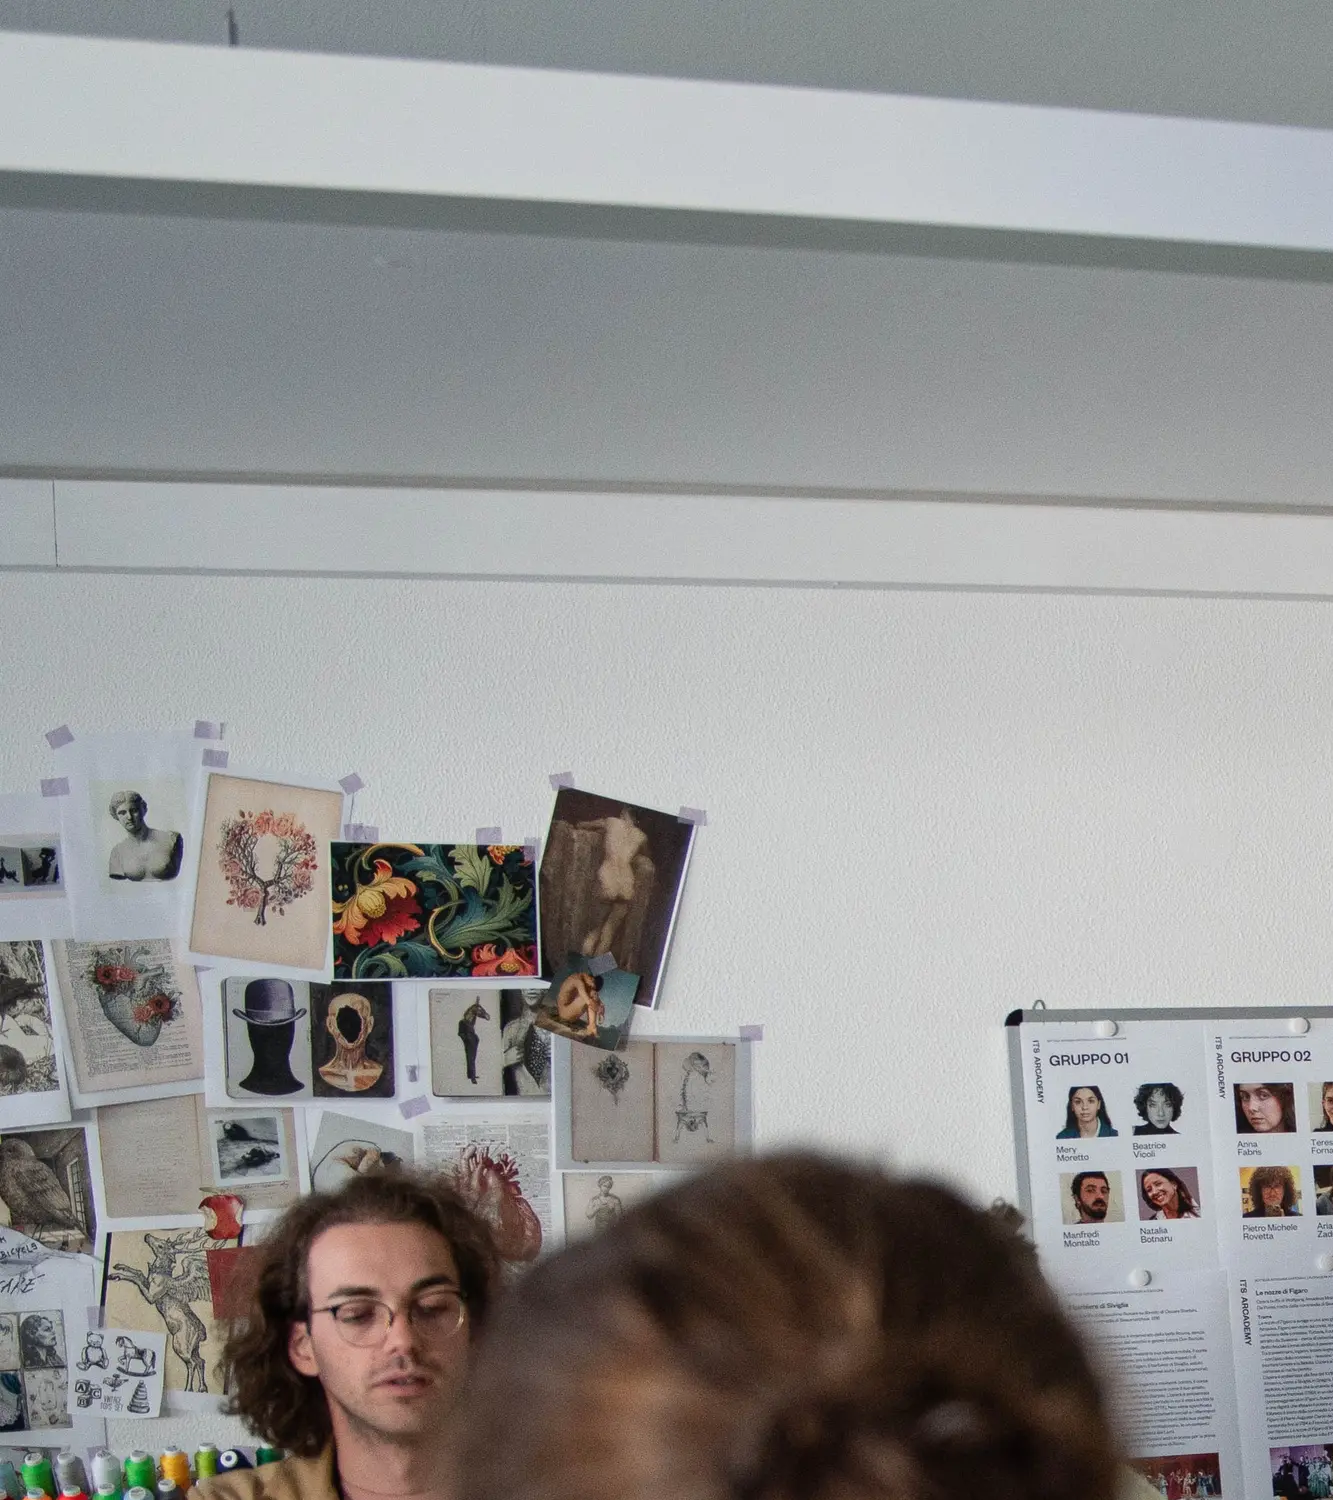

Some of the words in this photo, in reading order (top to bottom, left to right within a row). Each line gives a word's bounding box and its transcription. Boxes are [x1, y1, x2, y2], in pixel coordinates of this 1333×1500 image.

[1032, 1039, 1040, 1053] ITS
[1049, 1053, 1111, 1067] GRUPPO
[1114, 1052, 1129, 1064] 01
[1231, 1051, 1291, 1063] GRUPPO
[1294, 1050, 1312, 1062] 02
[1034, 1056, 1045, 1104] ARCADEMY
[1216, 1052, 1226, 1099] ARCADEMY
[1133, 1142, 1166, 1150] Beatrice
[1133, 1150, 1156, 1158] Vicoli
[1237, 1148, 1262, 1156] Fabris
[1057, 1154, 1089, 1162] Moretto
[1140, 1227, 1168, 1235] Natalia
[1242, 1225, 1267, 1233] Pietro
[1267, 1223, 1298, 1232] Michele
[1063, 1231, 1100, 1240] Manfredi
[1140, 1235, 1173, 1244] Botnaru
[1243, 1232, 1274, 1240] Rovetta
[1064, 1239, 1100, 1248] Montalto
[1239, 1279, 1248, 1294] ITS
[1289, 1287, 1308, 1295] Figaro
[1240, 1296, 1252, 1346] ARCADEMY
